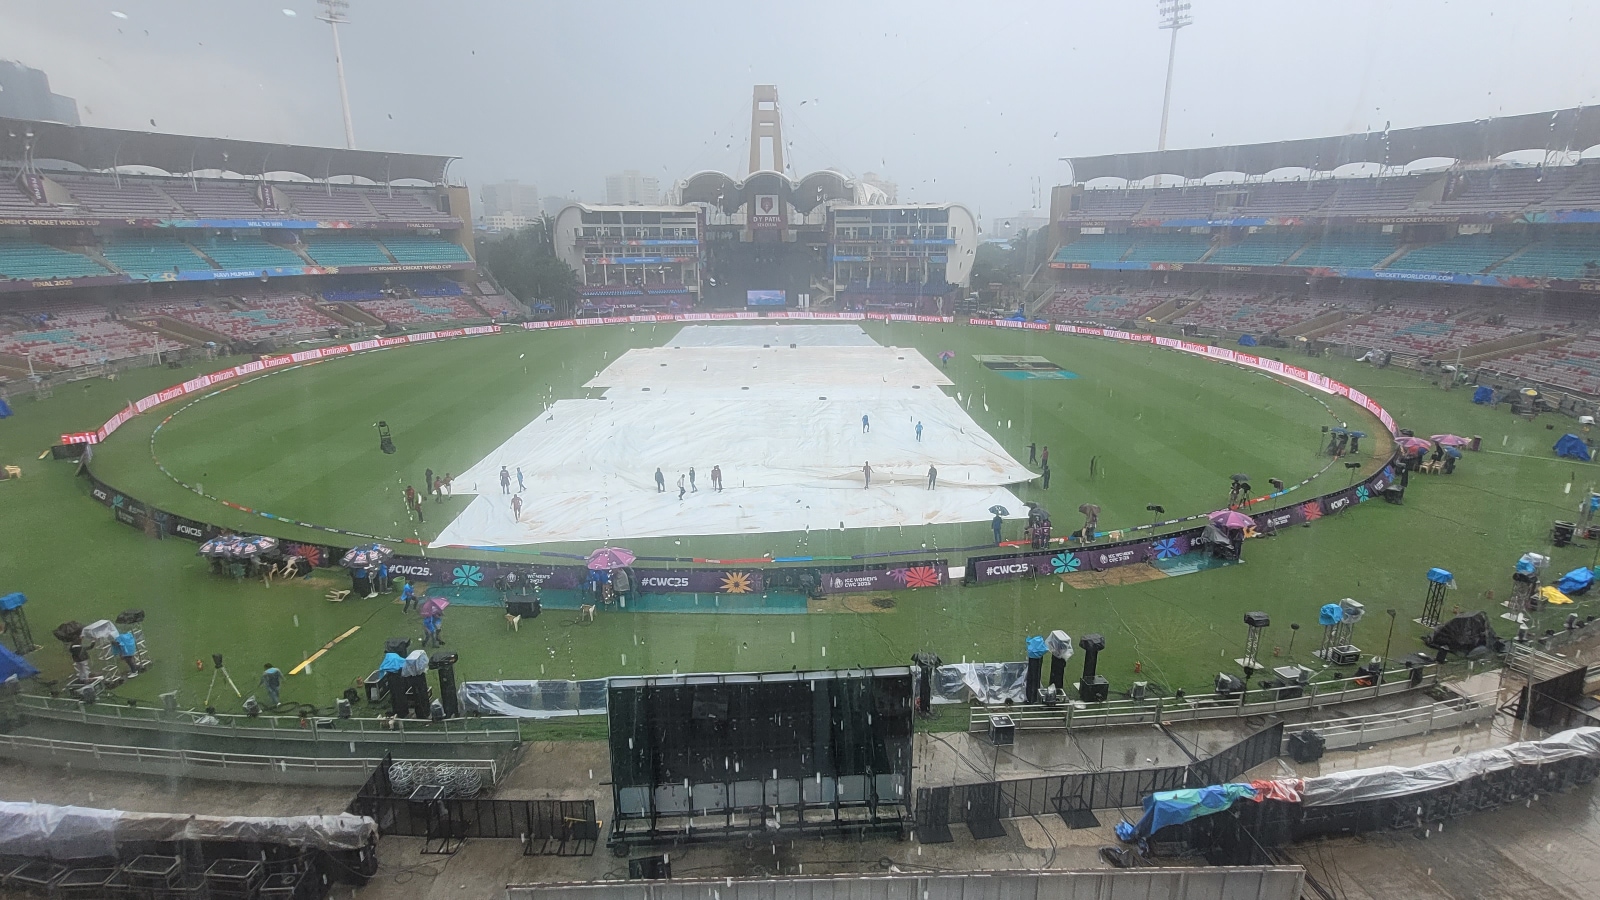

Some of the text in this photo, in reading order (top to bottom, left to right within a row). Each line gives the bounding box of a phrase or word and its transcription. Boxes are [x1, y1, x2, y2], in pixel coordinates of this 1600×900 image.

[1375, 272, 1454, 281] CRICKETWORLDCUP.COM
[32, 279, 73, 288] FINAL 2025
[549, 319, 574, 327] Emirates
[917, 315, 941, 323] Emirates
[970, 318, 994, 326] Emirates
[1023, 322, 1047, 330] Emirates
[1077, 326, 1101, 336] Emirates
[437, 329, 463, 339] Emirates
[380, 337, 406, 346] Emirates
[322, 345, 349, 357] Emirates
[1183, 343, 1205, 353] Emirates
[264, 355, 291, 368] Emirates
[210, 371, 235, 386] Emirates
[159, 388, 184, 403] Emirates
[176, 523, 202, 537] #CWC25
[388, 565, 430, 577] #CWC25
[986, 563, 1029, 576] #CWC25
[641, 577, 689, 588] #CWC25
